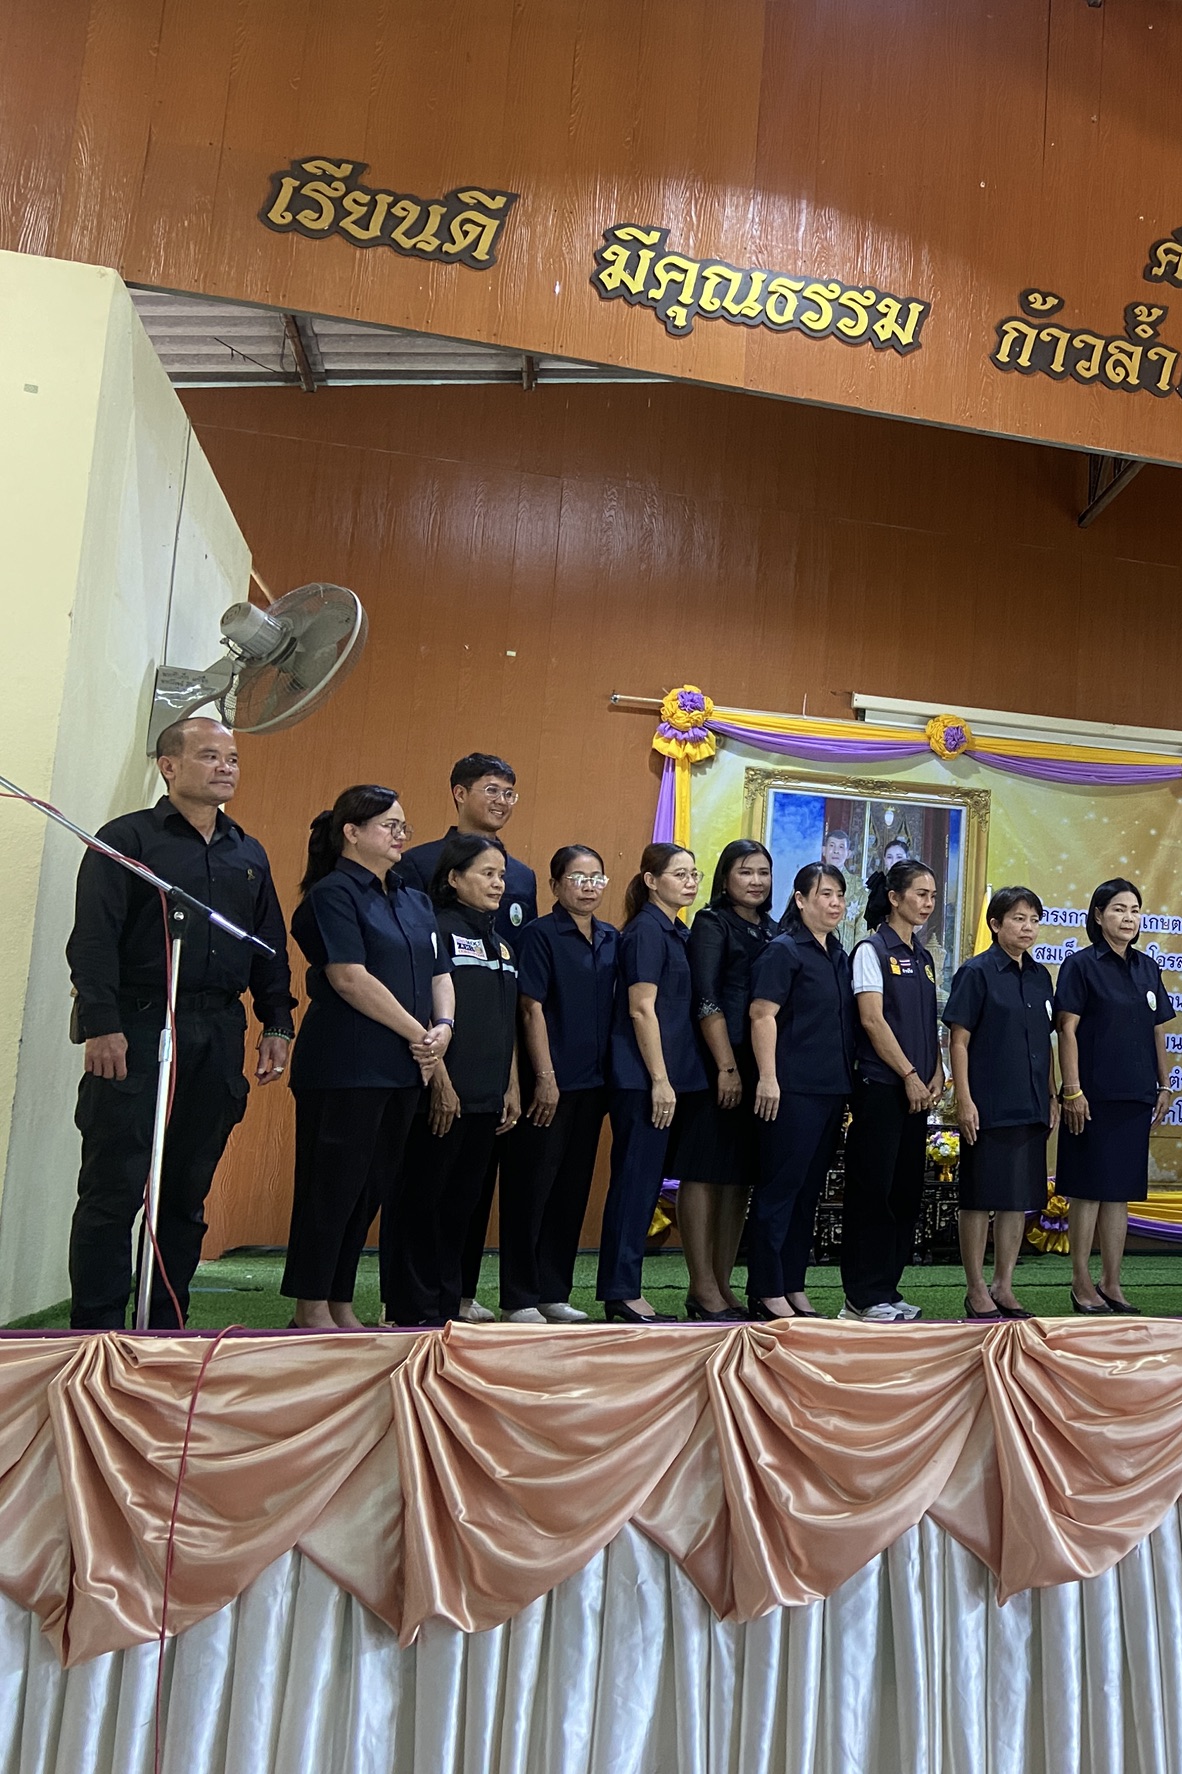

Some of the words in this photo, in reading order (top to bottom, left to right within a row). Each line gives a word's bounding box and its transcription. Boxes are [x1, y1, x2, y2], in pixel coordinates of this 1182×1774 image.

[267, 159, 506, 260] เรียนดี
[599, 226, 924, 346] มีคุณธรรม
